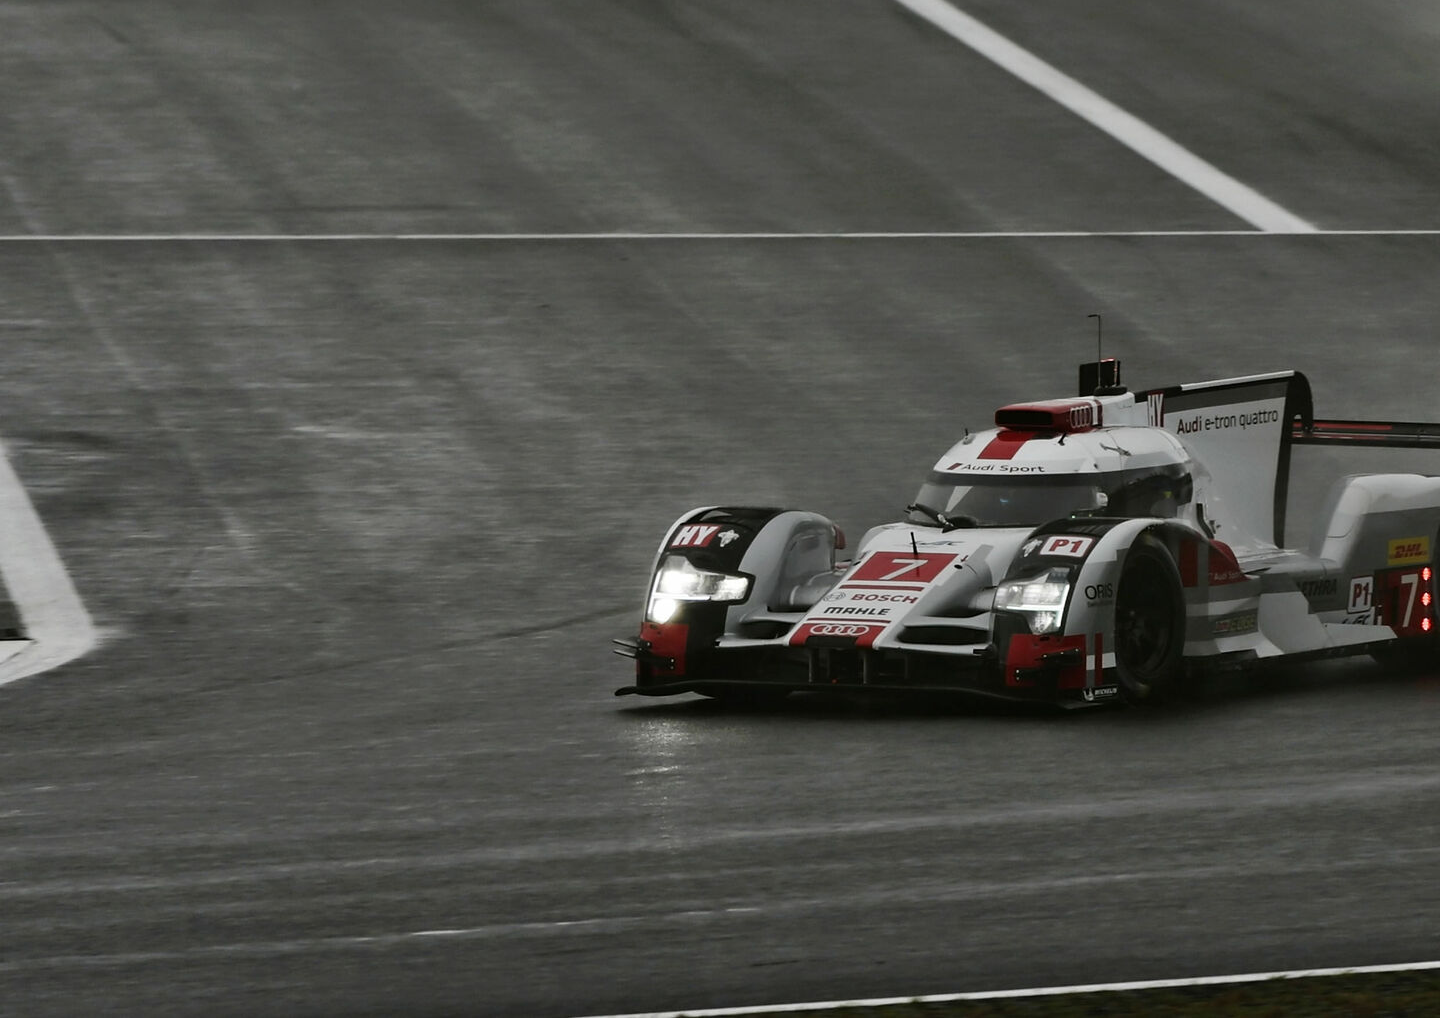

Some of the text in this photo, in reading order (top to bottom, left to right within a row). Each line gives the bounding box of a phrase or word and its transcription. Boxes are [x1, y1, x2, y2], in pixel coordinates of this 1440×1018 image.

[1147, 393, 1164, 427] HY
[1176, 408, 1279, 435] Audi e-tron quattro
[962, 461, 1046, 475] Audi Sport
[672, 525, 712, 548] HY
[1048, 538, 1082, 554] P1
[1394, 542, 1423, 559] DHL
[877, 557, 928, 581] 7
[850, 593, 919, 605] BOSCH
[1084, 582, 1113, 600] ORIS
[1351, 582, 1370, 608] P1
[1400, 573, 1419, 628] 7
[823, 605, 891, 617] MAHLE
